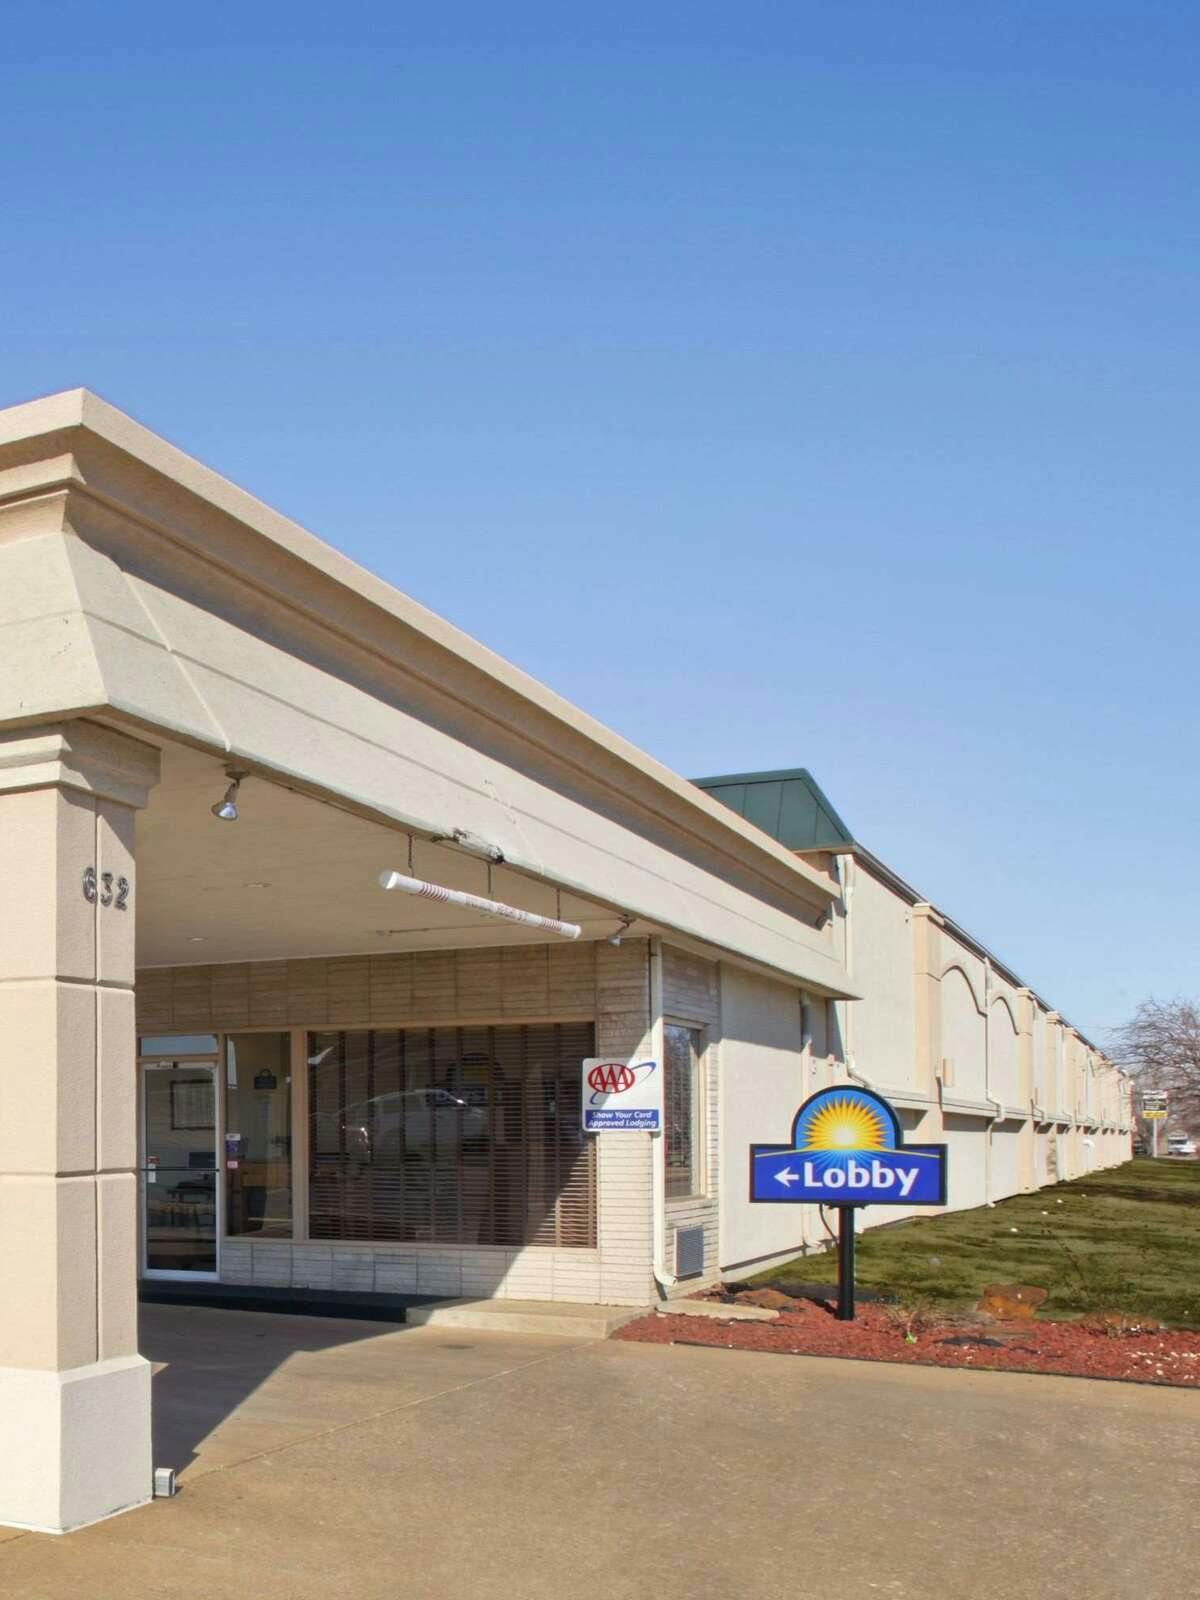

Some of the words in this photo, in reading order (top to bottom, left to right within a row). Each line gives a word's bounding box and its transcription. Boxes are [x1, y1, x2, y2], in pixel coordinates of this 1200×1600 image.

[83, 867, 129, 911] 632
[593, 1065, 631, 1093] AAA
[588, 1120, 624, 1128] Approved
[625, 1120, 657, 1128] Lodging
[592, 1111, 613, 1119] Show
[615, 1111, 632, 1119] Your
[634, 1111, 652, 1119] Card
[803, 1160, 920, 1196] Lobby
